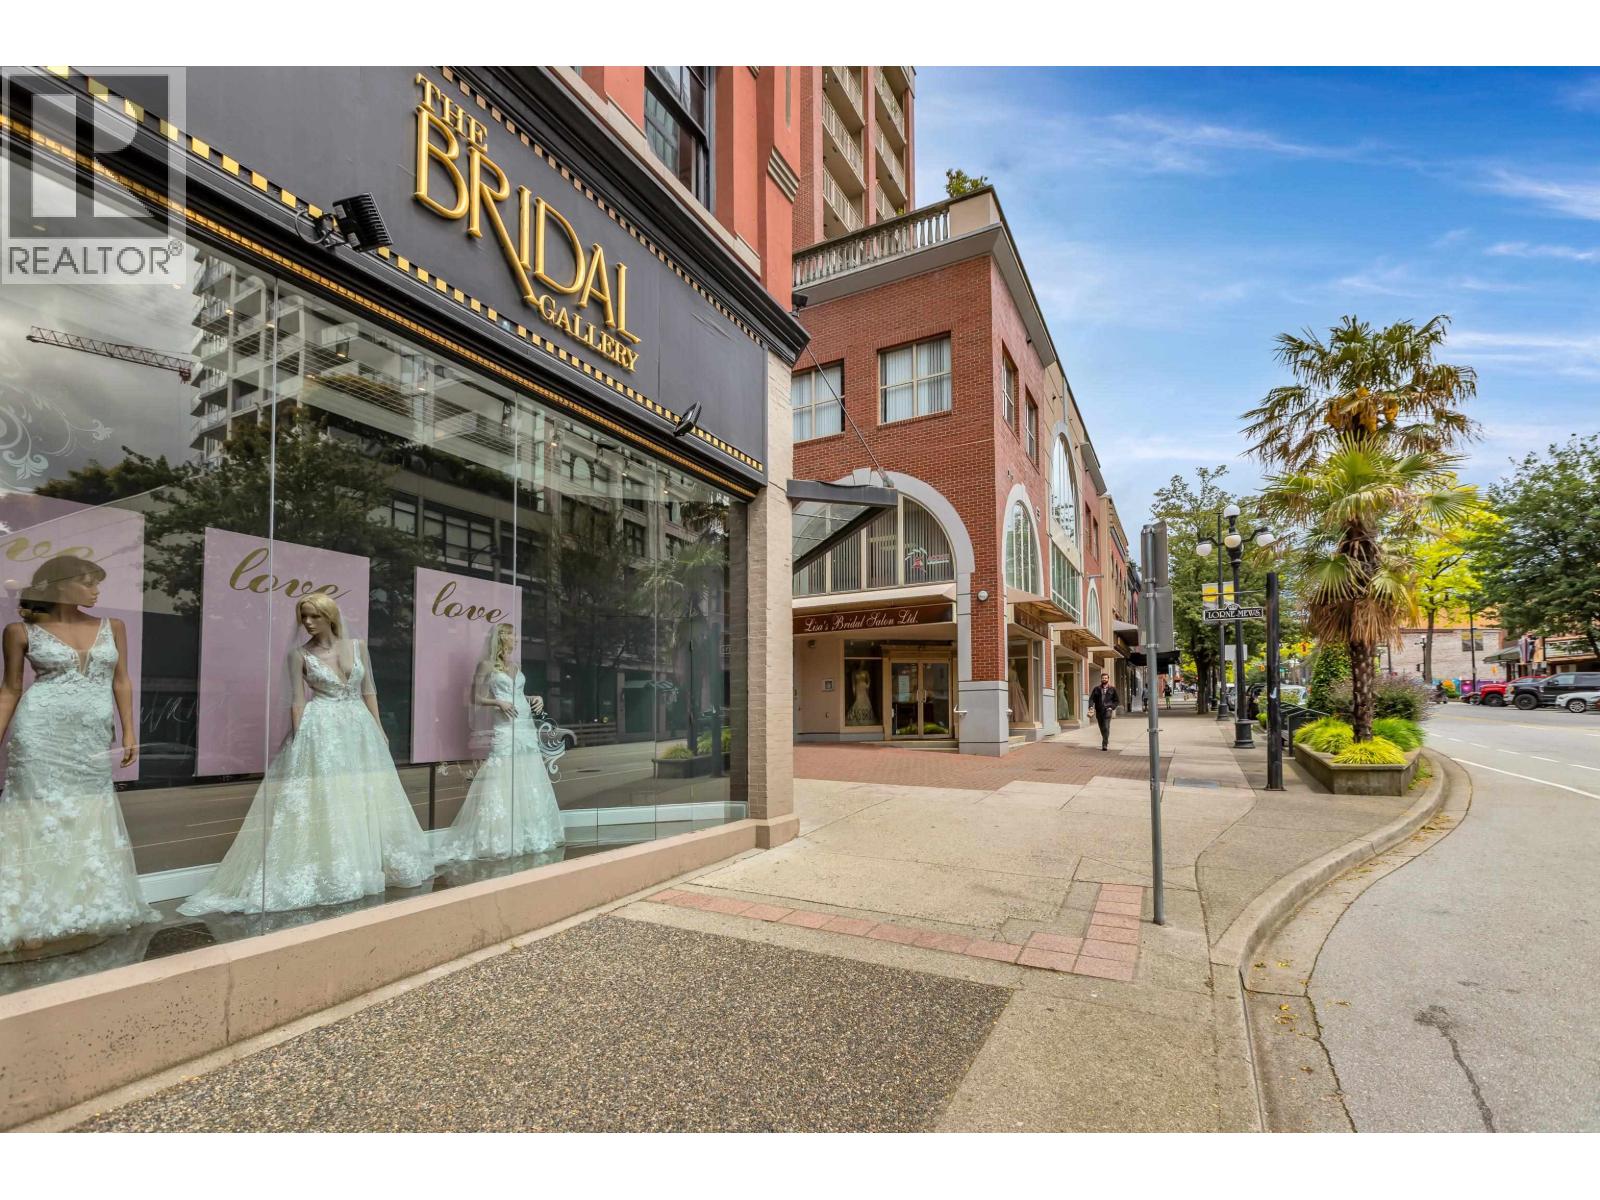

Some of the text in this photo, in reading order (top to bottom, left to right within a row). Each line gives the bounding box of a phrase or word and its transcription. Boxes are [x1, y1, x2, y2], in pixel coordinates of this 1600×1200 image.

[415, 72, 488, 152] THE
[413, 105, 641, 344] BRIDAL
[539, 294, 640, 373] GALLERY
[431, 580, 510, 624] love
[804, 609, 920, 632] Lisa's Bridal Salon Ltd.
[1208, 610, 1236, 619] LORNE
